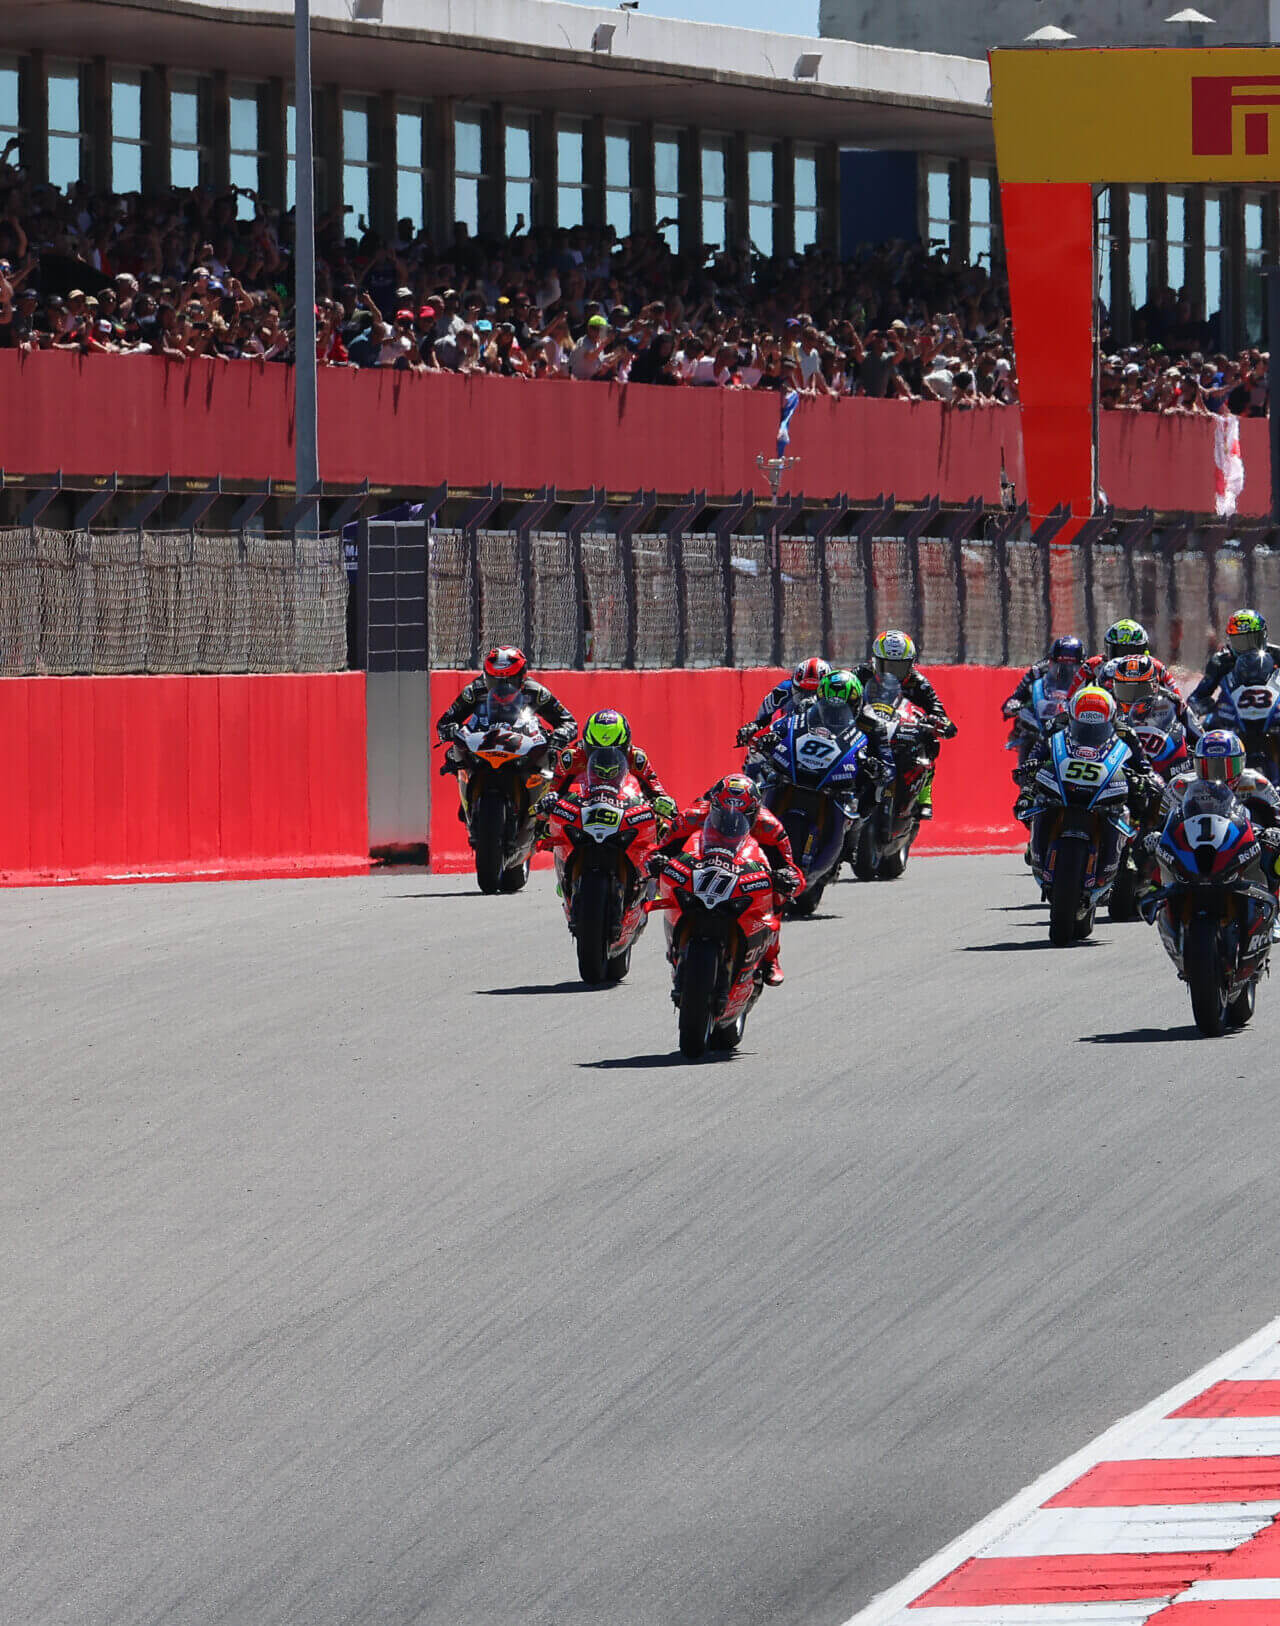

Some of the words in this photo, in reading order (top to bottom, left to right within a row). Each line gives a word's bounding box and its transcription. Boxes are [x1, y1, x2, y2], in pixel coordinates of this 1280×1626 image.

[799, 740, 835, 757] 87
[1065, 762, 1101, 781] 55
[627, 812, 652, 824] Lenovo
[1195, 816, 1216, 842] 1
[664, 866, 685, 883] Lenovo
[695, 870, 733, 896] 11
[742, 880, 769, 892] Lenovo
